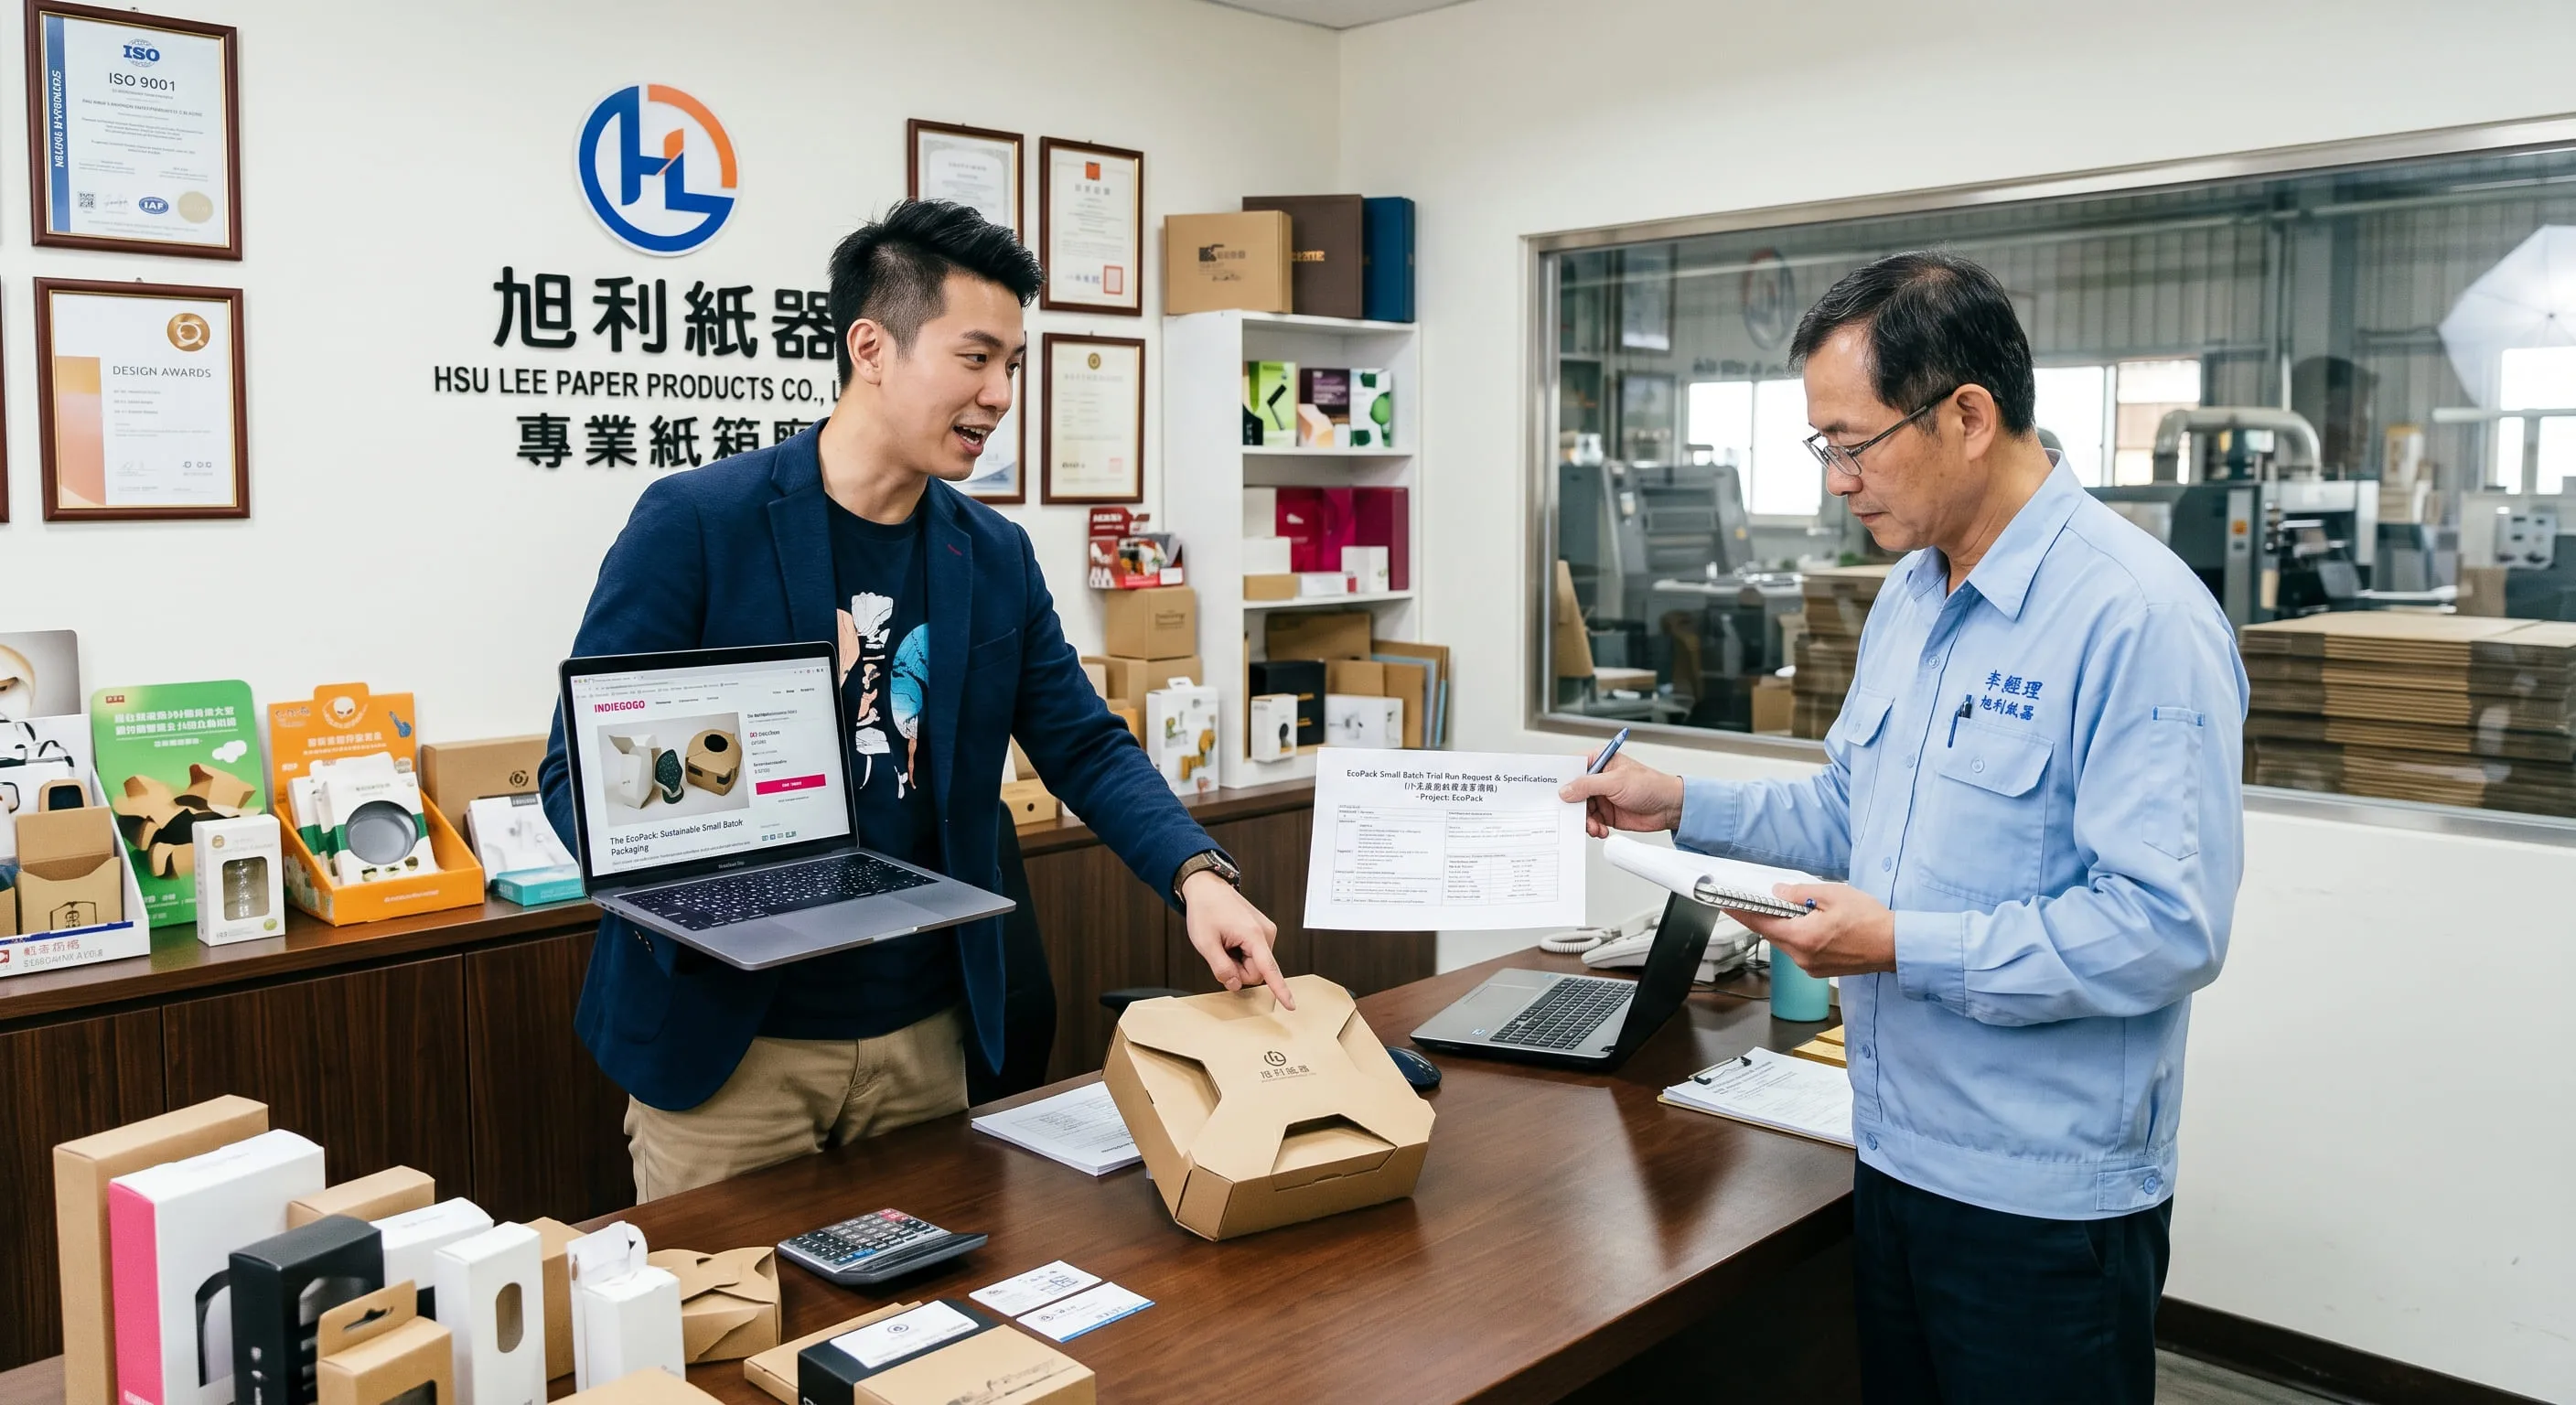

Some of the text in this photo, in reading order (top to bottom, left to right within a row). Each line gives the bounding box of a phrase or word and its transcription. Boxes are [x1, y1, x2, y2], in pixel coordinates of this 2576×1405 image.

[123, 44, 160, 62] ISO
[109, 72, 176, 91] ISO 9001
[144, 201, 164, 210] IAF
[492, 265, 836, 360] 旭利紙器
[113, 365, 211, 378] DESIGN AWARDS
[434, 365, 488, 393] HSU
[499, 368, 548, 394] LEE
[556, 370, 639, 397] PAPER
[647, 372, 774, 401] PRODUCTS
[781, 377, 824, 406] CO.,
[594, 700, 646, 713] INDIEGOGO
[1347, 769, 1378, 778] EcoPack
[1379, 770, 1401, 778] Small
[1402, 771, 1424, 779] Batch
[1444, 772, 1460, 780] Run
[1452, 794, 1484, 802] EcoPack
[610, 837, 624, 845] The
[626, 831, 659, 843] EcoPack:
[660, 826, 701, 838] Sustainable
[702, 821, 722, 832] Small
[611, 844, 649, 856] Packaging
